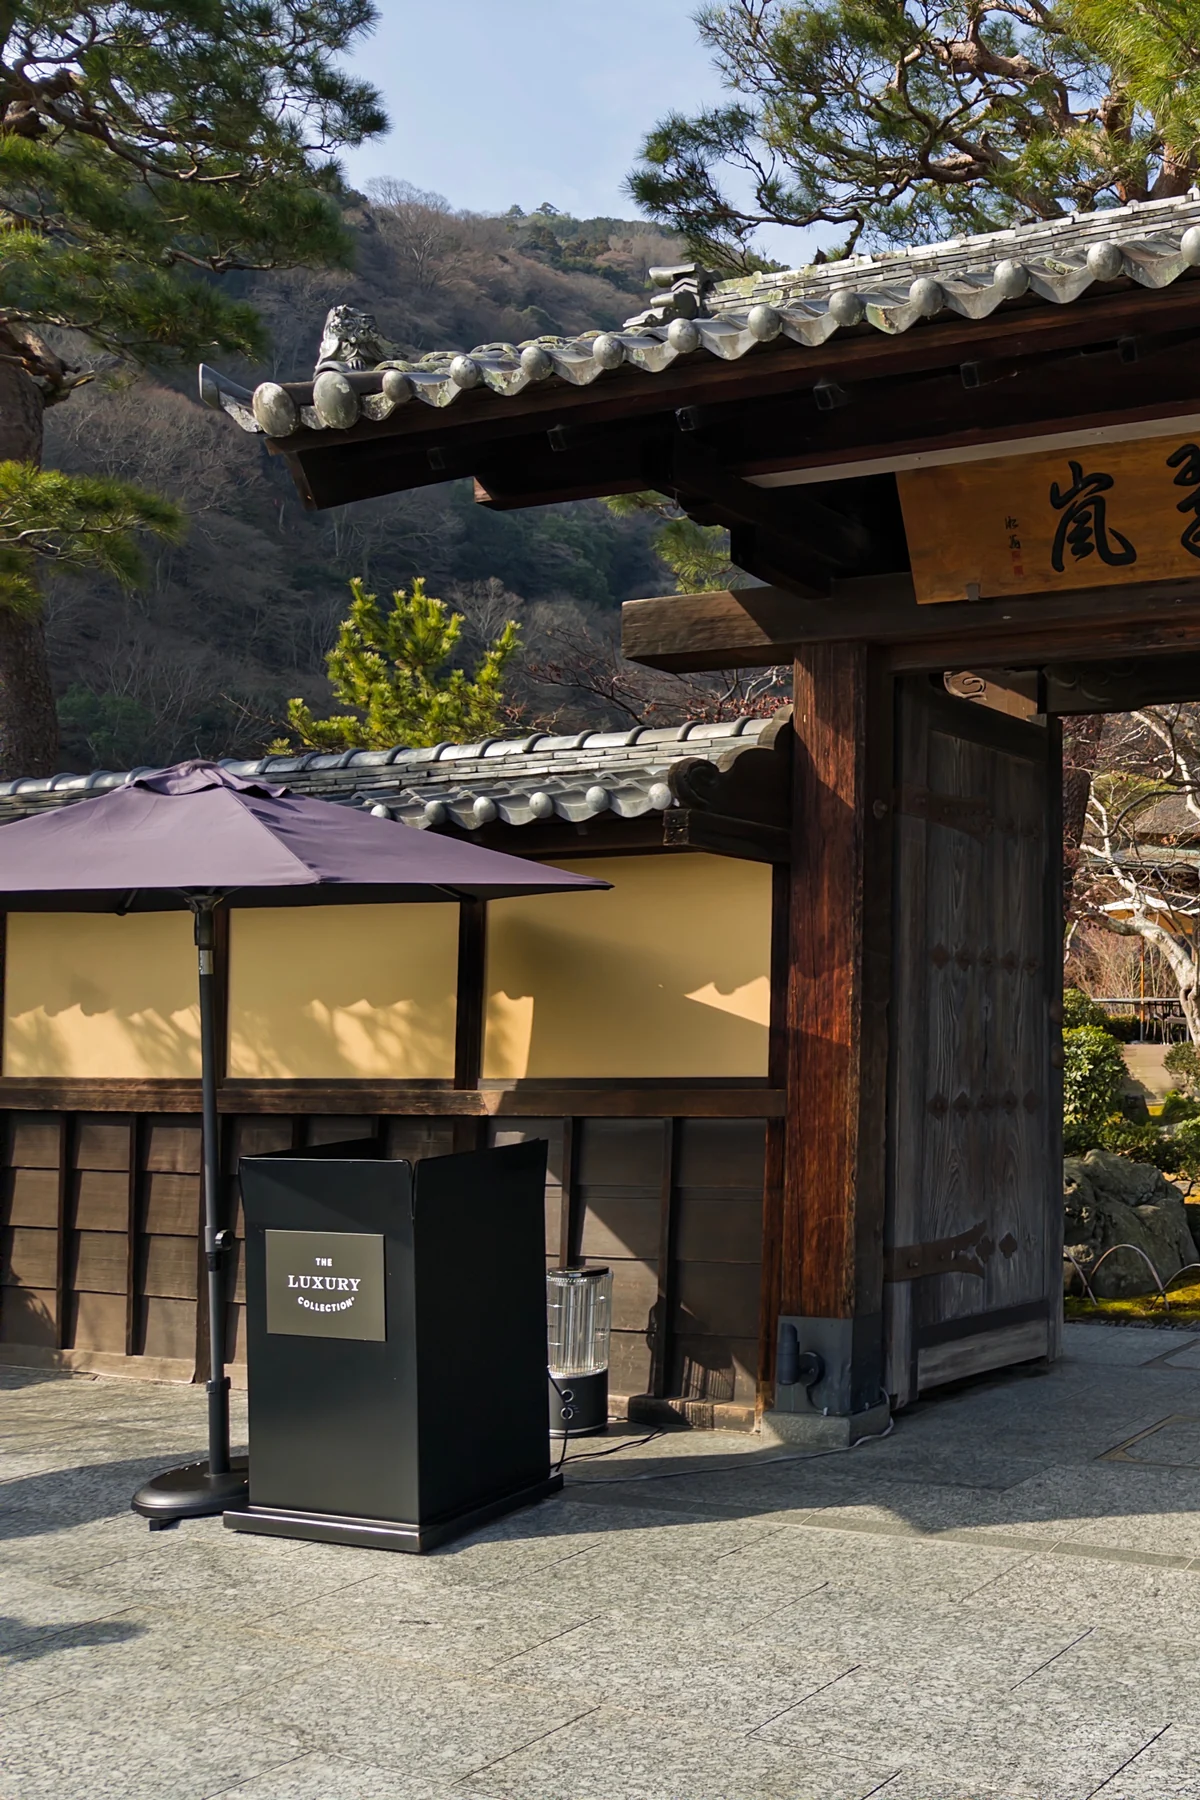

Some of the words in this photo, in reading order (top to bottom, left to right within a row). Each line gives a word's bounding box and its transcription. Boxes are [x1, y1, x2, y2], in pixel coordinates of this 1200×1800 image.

[315, 1257, 333, 1267] THE
[287, 1274, 361, 1292] LUXURY
[297, 1296, 354, 1312] COLLECTION
